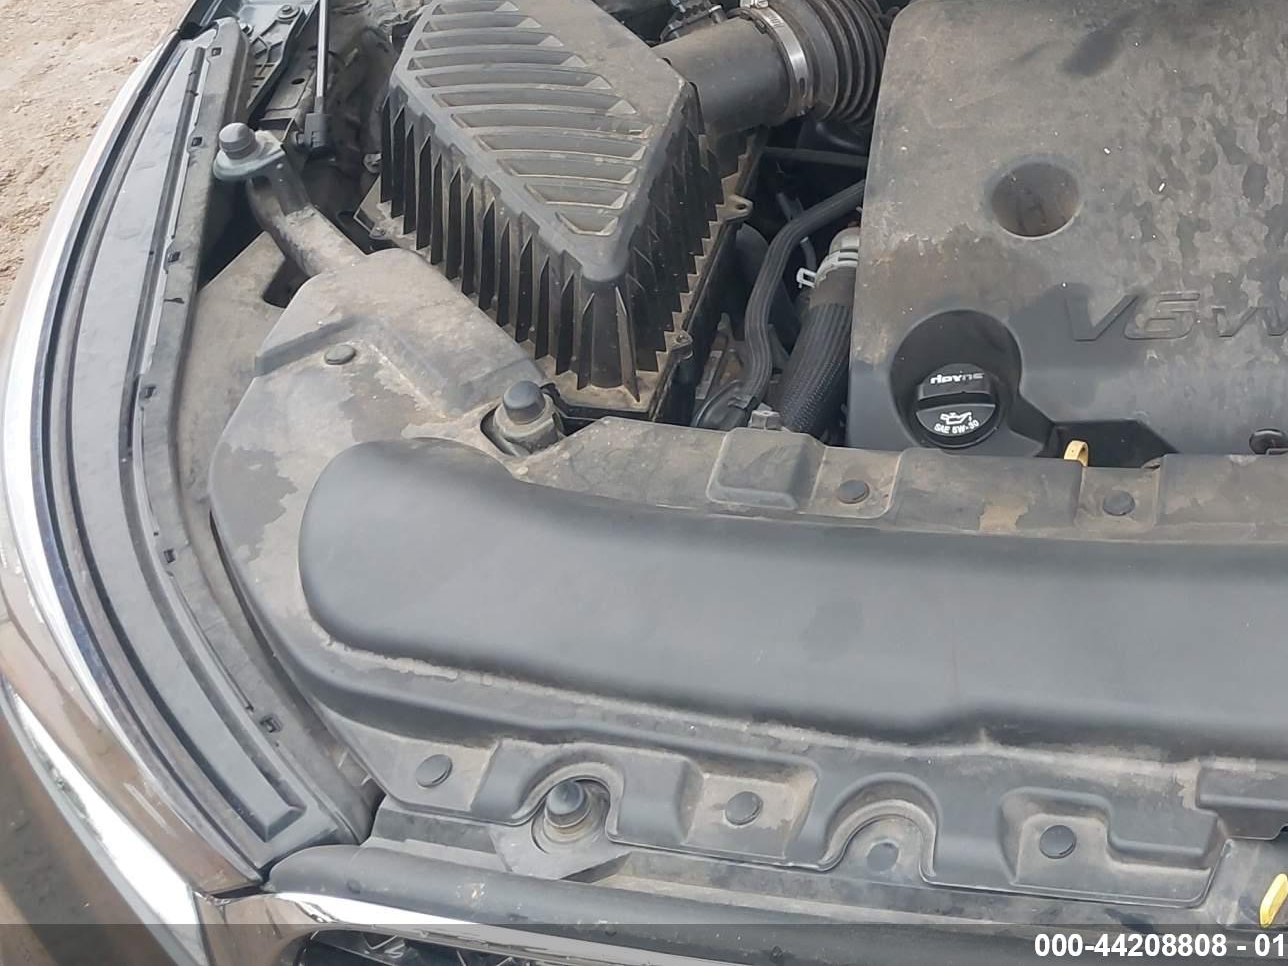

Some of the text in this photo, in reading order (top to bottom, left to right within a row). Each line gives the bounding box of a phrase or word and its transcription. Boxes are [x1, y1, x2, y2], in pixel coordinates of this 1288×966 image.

[1064, 291, 1201, 342] V6
[933, 419, 980, 434] SAE 5W-30
